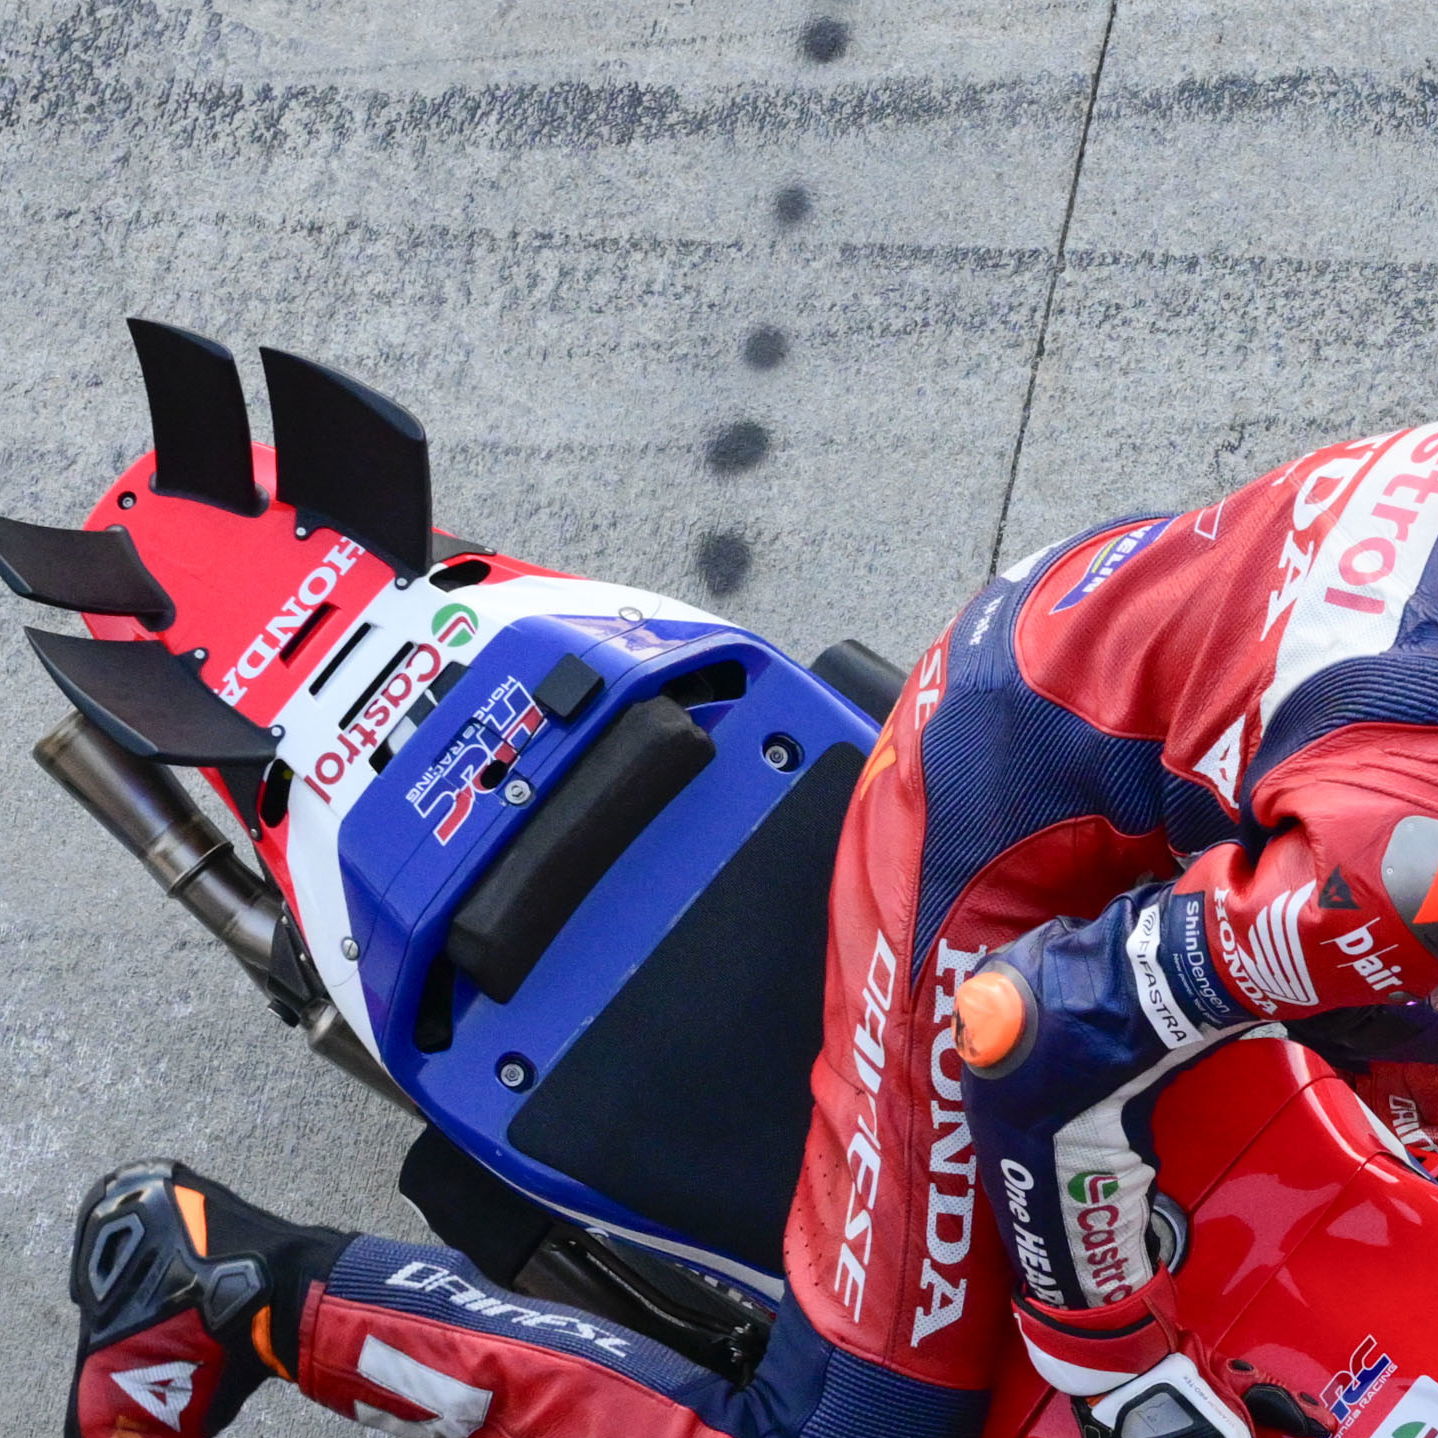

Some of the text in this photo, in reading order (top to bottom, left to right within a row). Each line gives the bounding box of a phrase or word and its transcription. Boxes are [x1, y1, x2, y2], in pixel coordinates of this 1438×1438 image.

[303, 642, 442, 804] Castrol
[412, 681, 548, 846] HRC
[1185, 901, 1231, 1015] ShinDengen
[1214, 886, 1278, 1016] HONDA
[834, 929, 897, 1324] DAINESE
[911, 938, 988, 1348] HONDA
[384, 1261, 632, 1358] DAINESE
[1000, 1158, 1068, 1310] One HEAR
[1359, 1363, 1399, 1410] RACING
